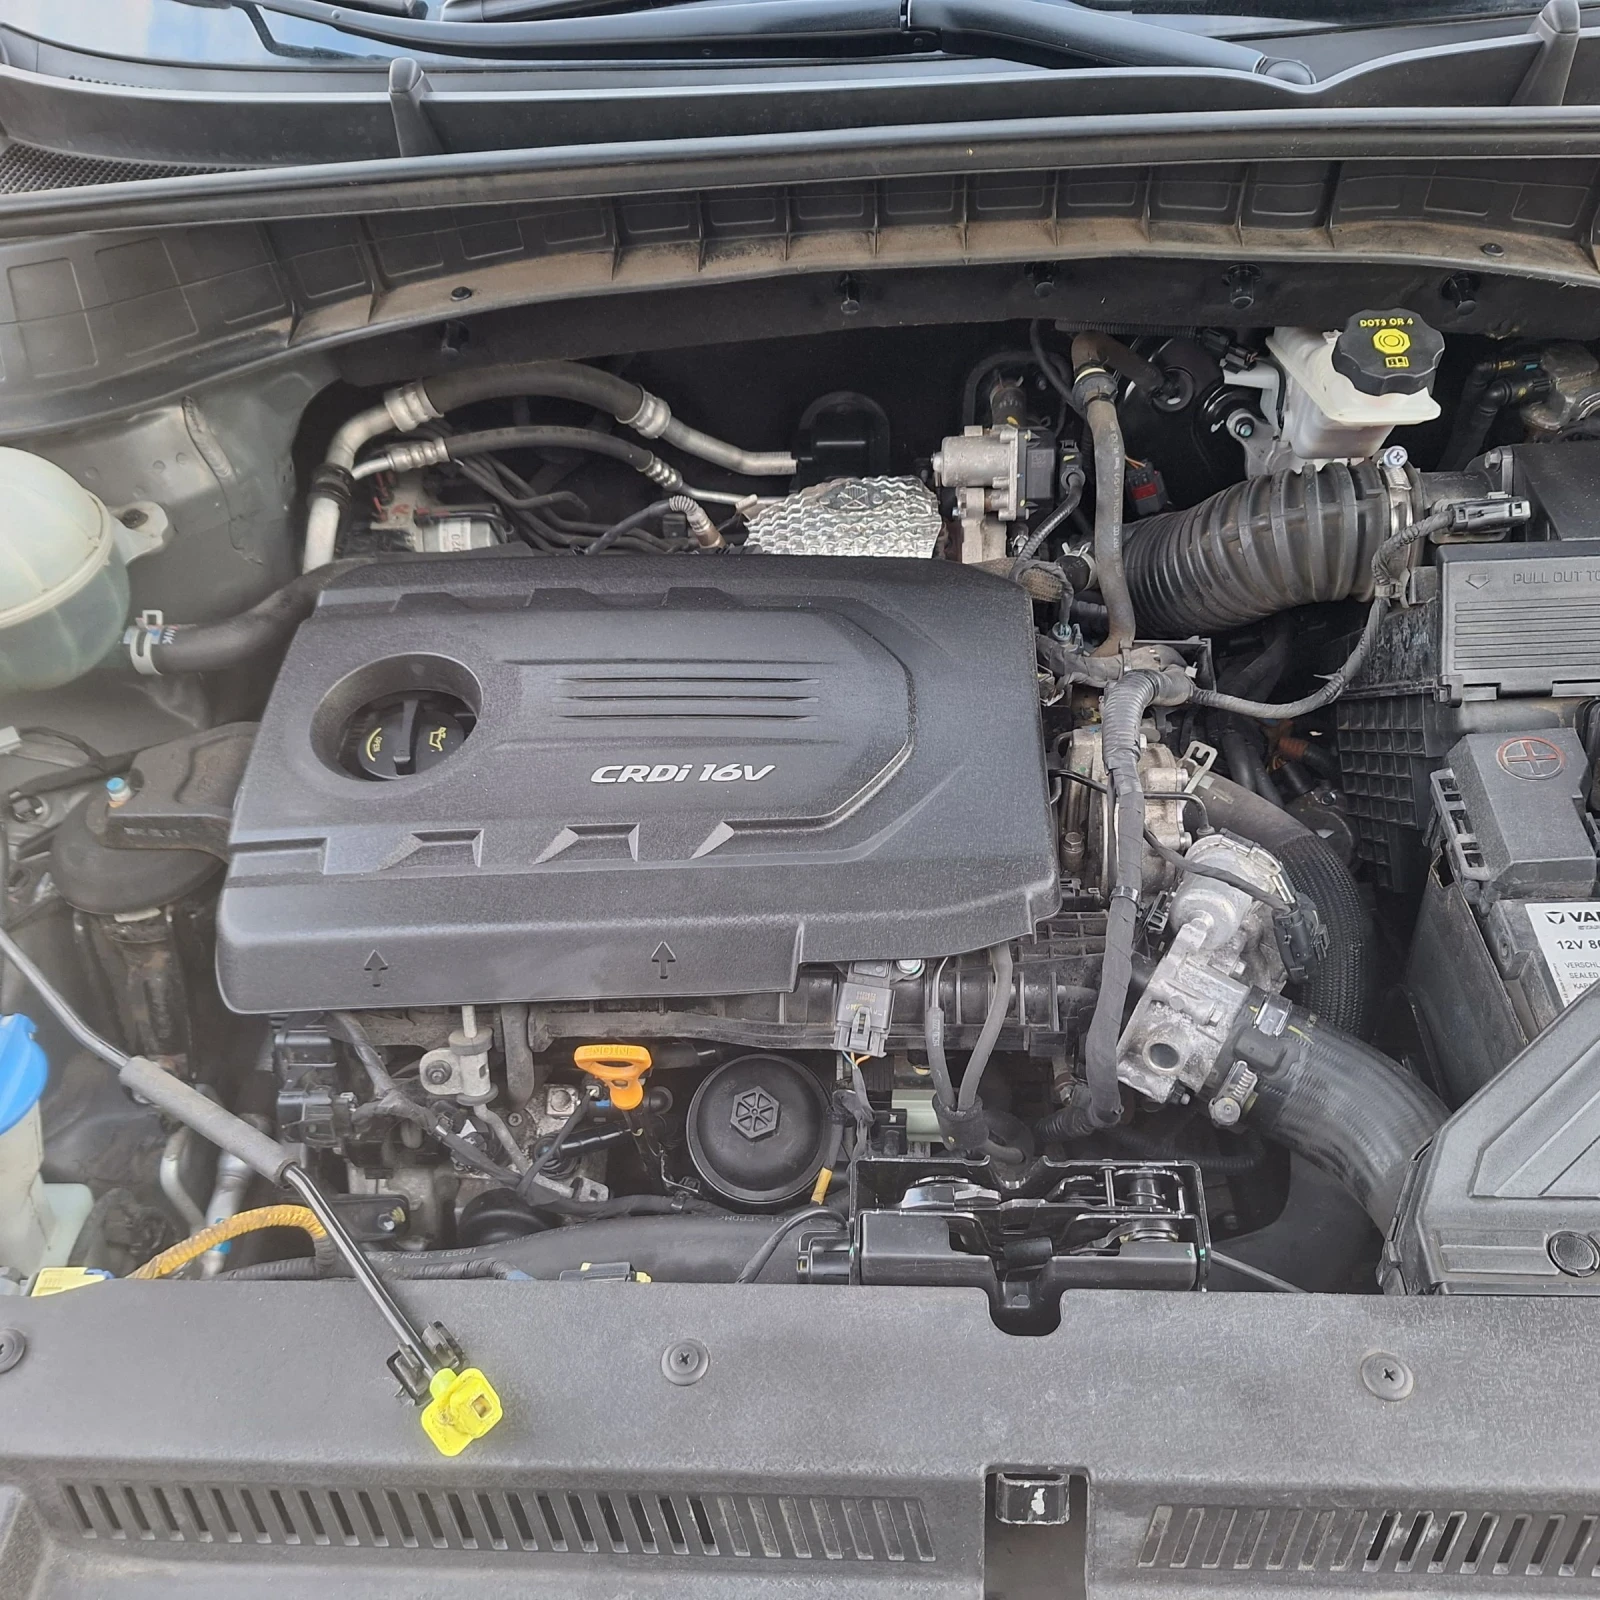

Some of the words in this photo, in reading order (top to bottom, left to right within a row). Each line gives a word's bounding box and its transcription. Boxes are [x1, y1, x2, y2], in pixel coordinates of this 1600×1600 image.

[1360, 319, 1387, 327] DOT3
[1389, 318, 1405, 326] OR
[1407, 317, 1414, 325] 4
[1513, 572, 1549, 585] PULL
[1553, 570, 1583, 583] OUT
[372, 736, 383, 753] OPEN
[590, 763, 693, 783] CRDi
[699, 763, 776, 782] 16V
[1567, 911, 1600, 923] VA
[1556, 939, 1583, 950] 12V
[1588, 939, 1600, 950] 8
[1569, 971, 1599, 979] SEALED
[1572, 982, 1591, 990] KAP
